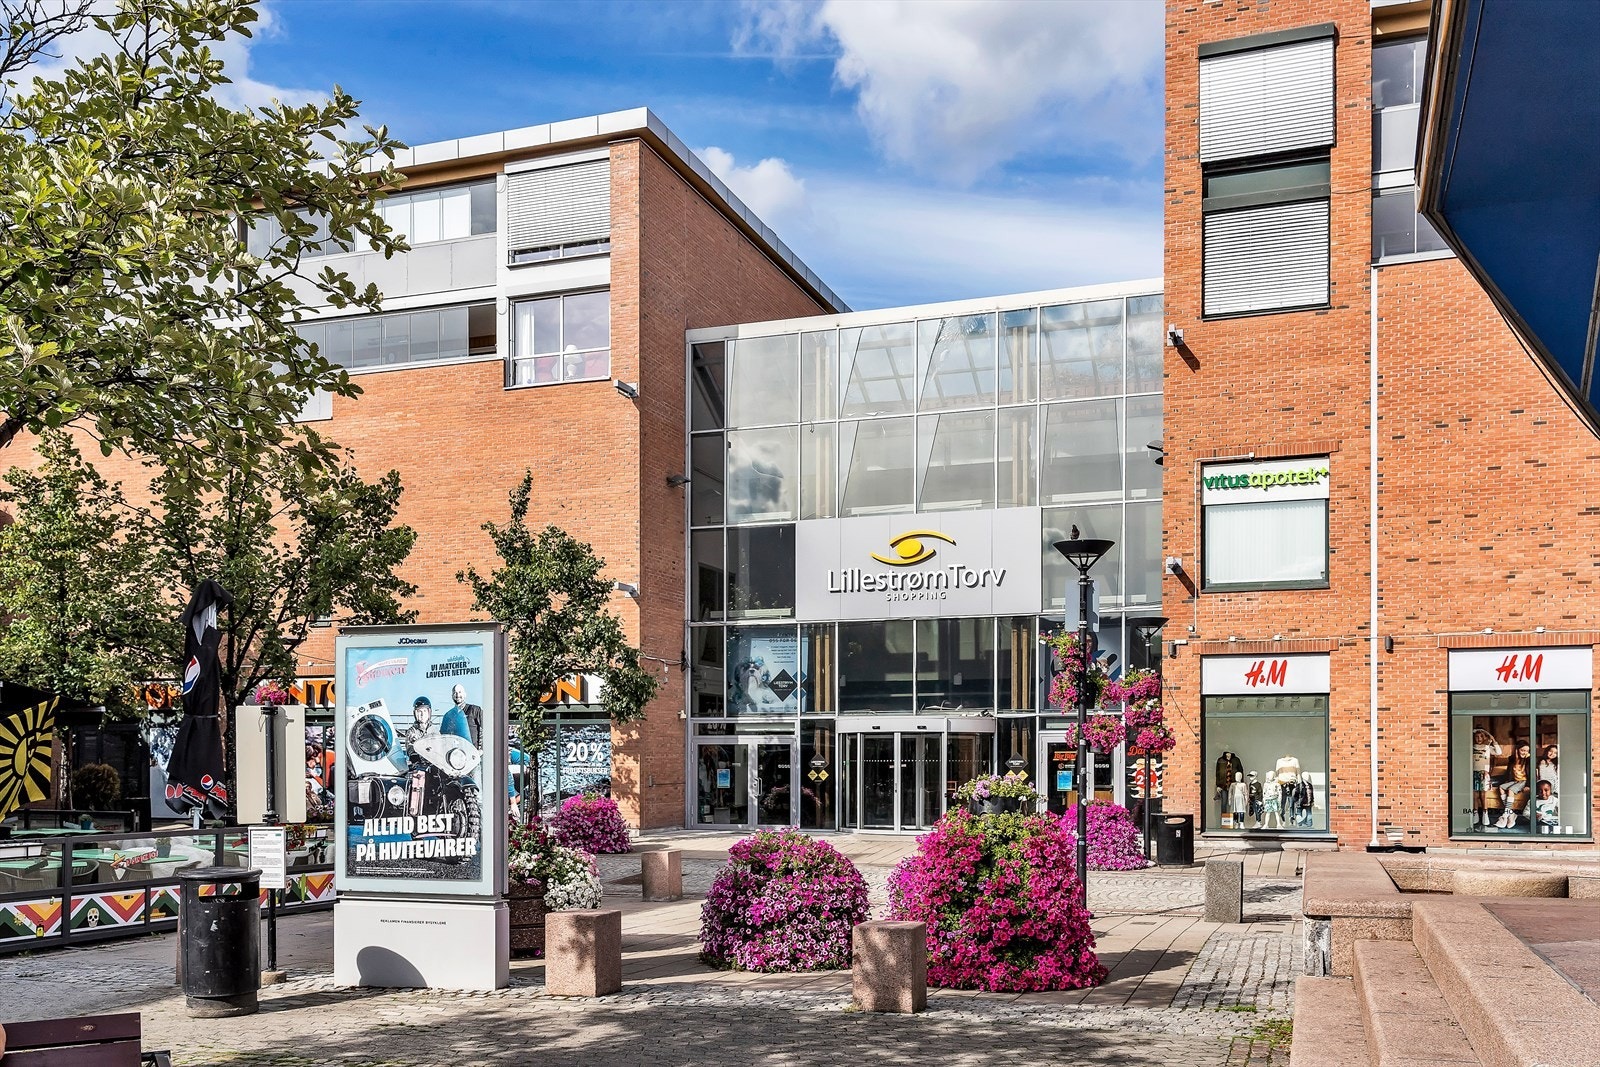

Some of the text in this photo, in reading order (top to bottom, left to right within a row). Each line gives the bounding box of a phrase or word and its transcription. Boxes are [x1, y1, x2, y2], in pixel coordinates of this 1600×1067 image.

[1203, 466, 1320, 491] vitusapotek
[827, 563, 1006, 592] Lillestrøm Torv
[886, 591, 947, 601] SHOPPING
[398, 637, 428, 645] JCDecaux
[426, 666, 480, 678] LAVESTE NETTPRIS
[439, 661, 467, 670] MATCHER
[1244, 659, 1288, 688] H&M
[1495, 654, 1544, 684] H&M
[566, 742, 604, 762] 20%
[363, 814, 455, 837] ALLTID BEST
[356, 838, 477, 862] PÅ HVITEVARER
